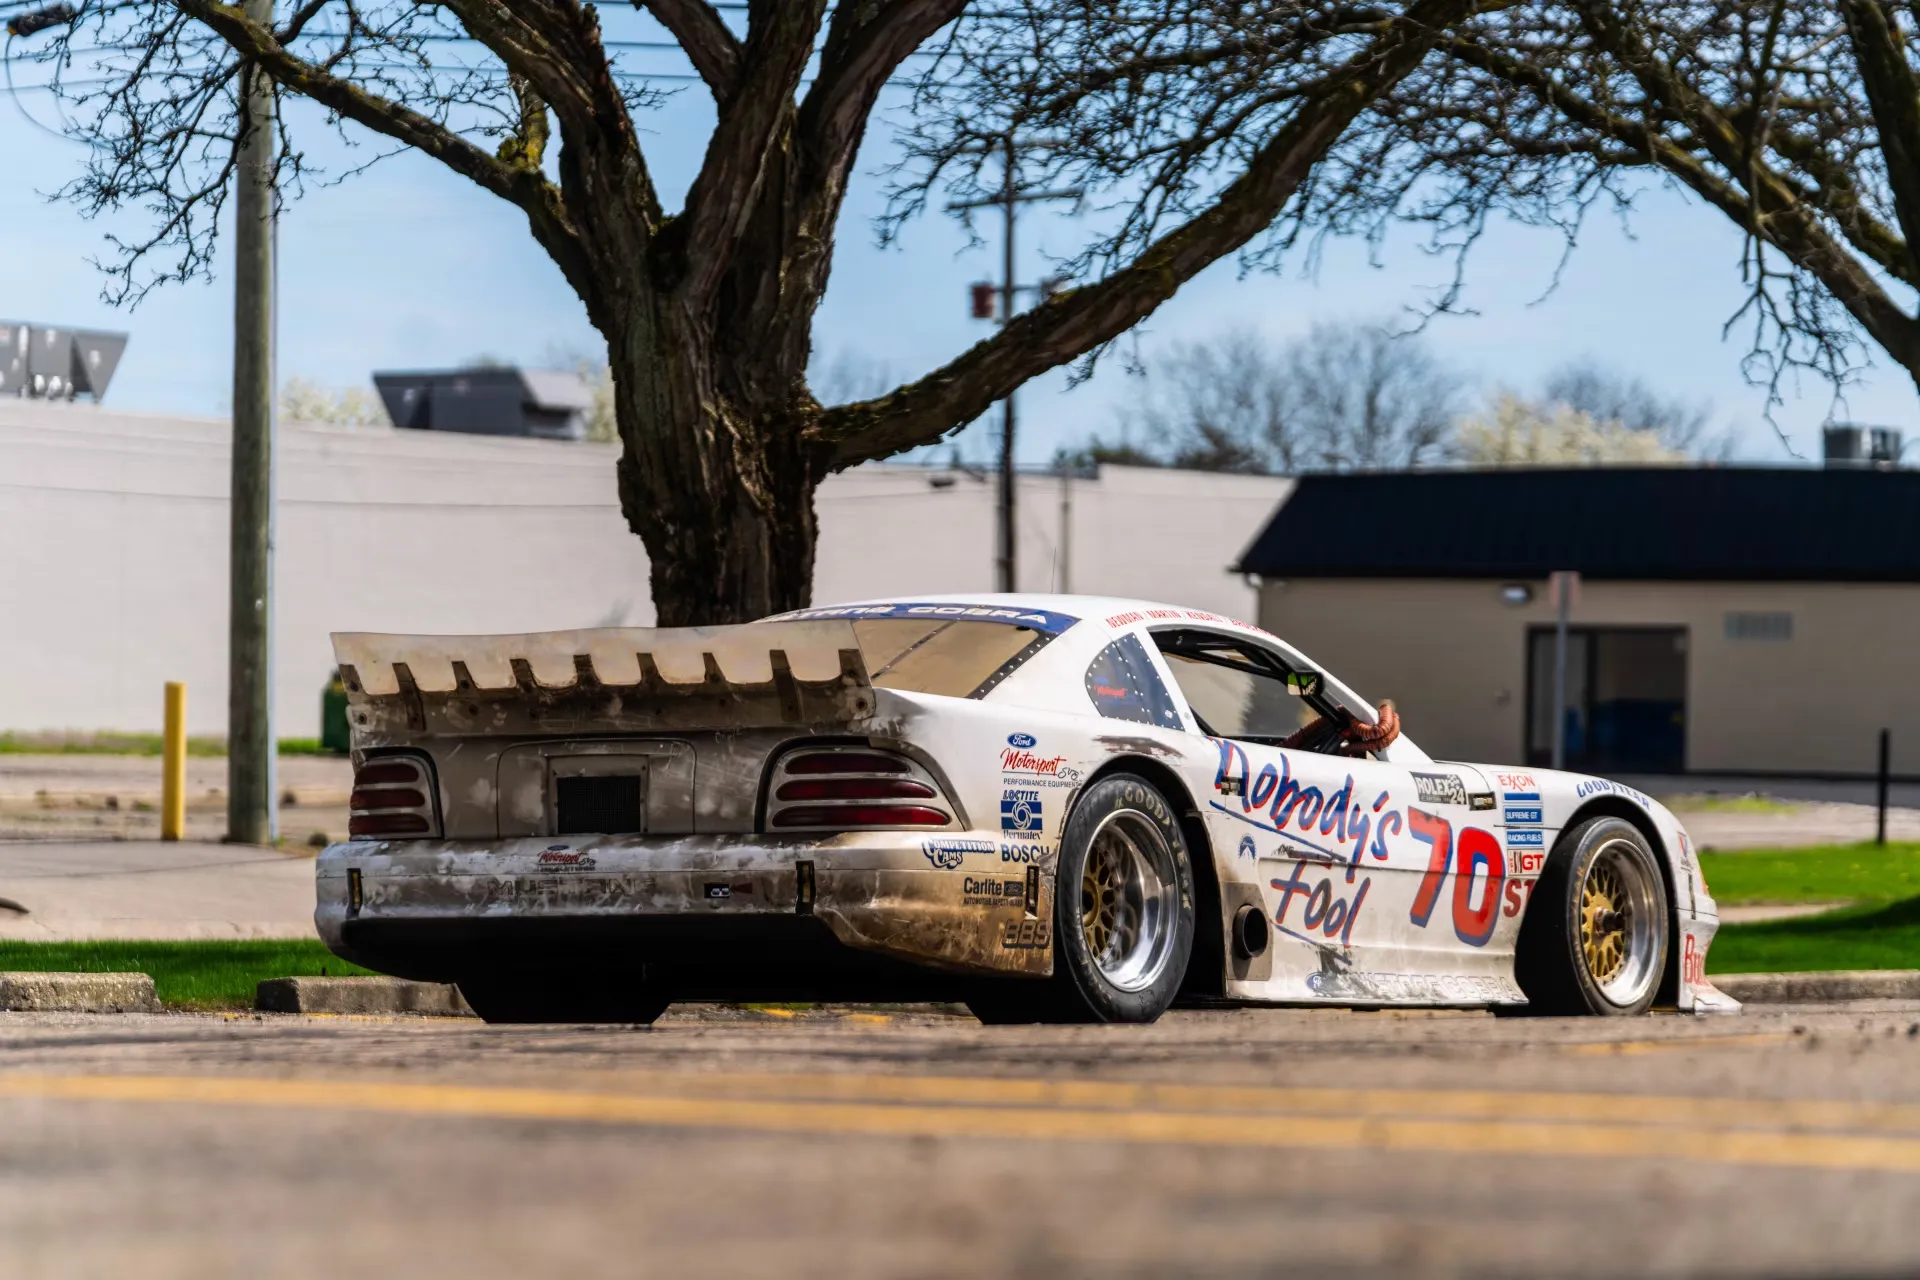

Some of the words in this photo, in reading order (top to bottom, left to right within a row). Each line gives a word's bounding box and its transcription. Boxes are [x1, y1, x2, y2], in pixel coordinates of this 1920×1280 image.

[908, 606, 1046, 624] COBRA
[1105, 611, 1145, 628] NEWMAN
[1146, 609, 1182, 620] MARTIN
[1187, 611, 1224, 623] KENDALL
[1012, 734, 1031, 748] Ford
[1000, 748, 1066, 776] Motorsport
[1003, 778, 1047, 787] PERFORMANCE
[1048, 780, 1079, 788] EQUIPMENT
[1415, 776, 1451, 795] ROLEX
[1450, 787, 1466, 804] 24
[1497, 774, 1536, 791] EXXON
[1002, 790, 1039, 800] LOCTITE
[1506, 811, 1529, 819] SUPREME
[1530, 811, 1538, 819] GT
[1003, 830, 1041, 840] Permatex
[1507, 833, 1526, 841] RACING
[1527, 834, 1542, 842] FUELS
[1522, 854, 1544, 870] GT
[1407, 805, 1506, 948] 70
[963, 876, 1002, 896] Carlite
